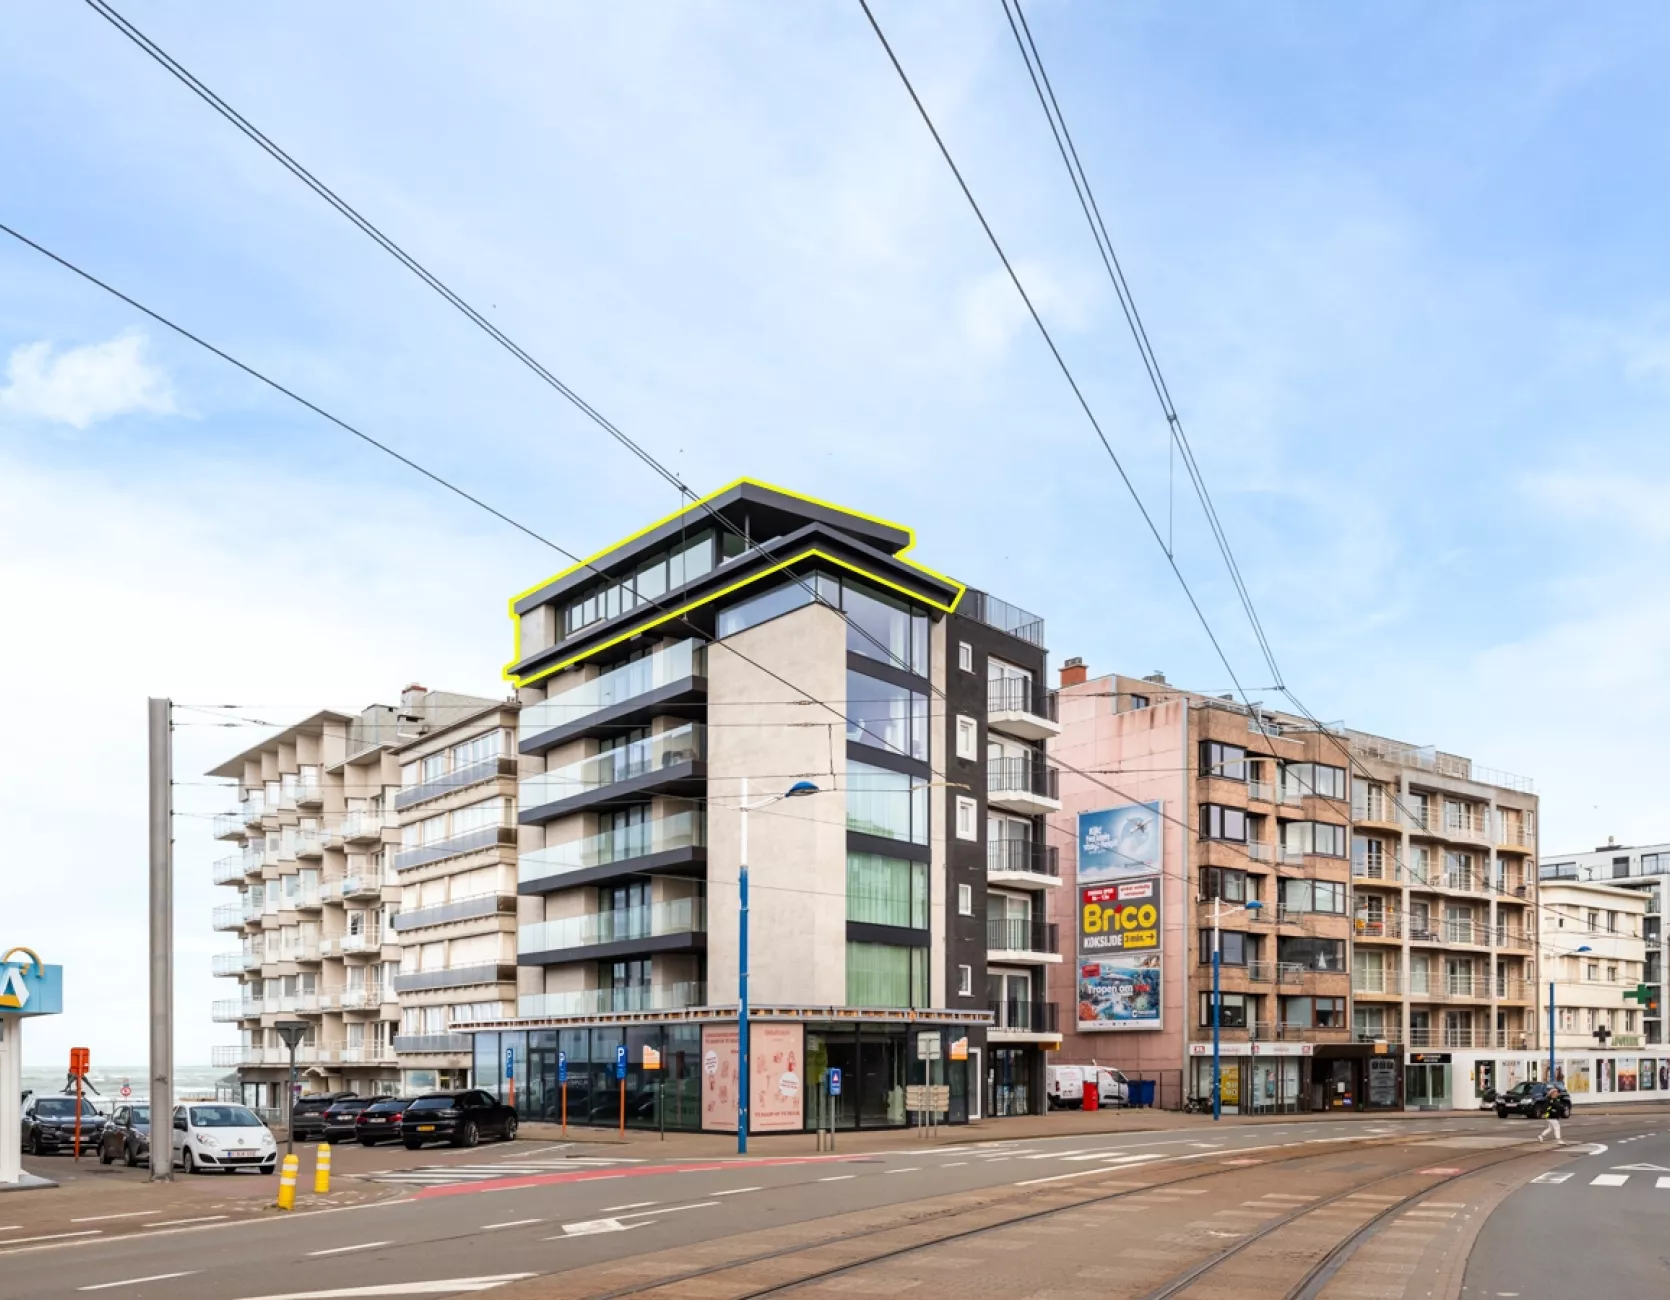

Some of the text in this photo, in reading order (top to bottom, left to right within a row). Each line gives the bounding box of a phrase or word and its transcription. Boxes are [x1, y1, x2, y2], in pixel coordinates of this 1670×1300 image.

[1083, 903, 1157, 934] Brico
[1083, 934, 1123, 949] KOKSIJDE
[617, 1048, 625, 1063] P
